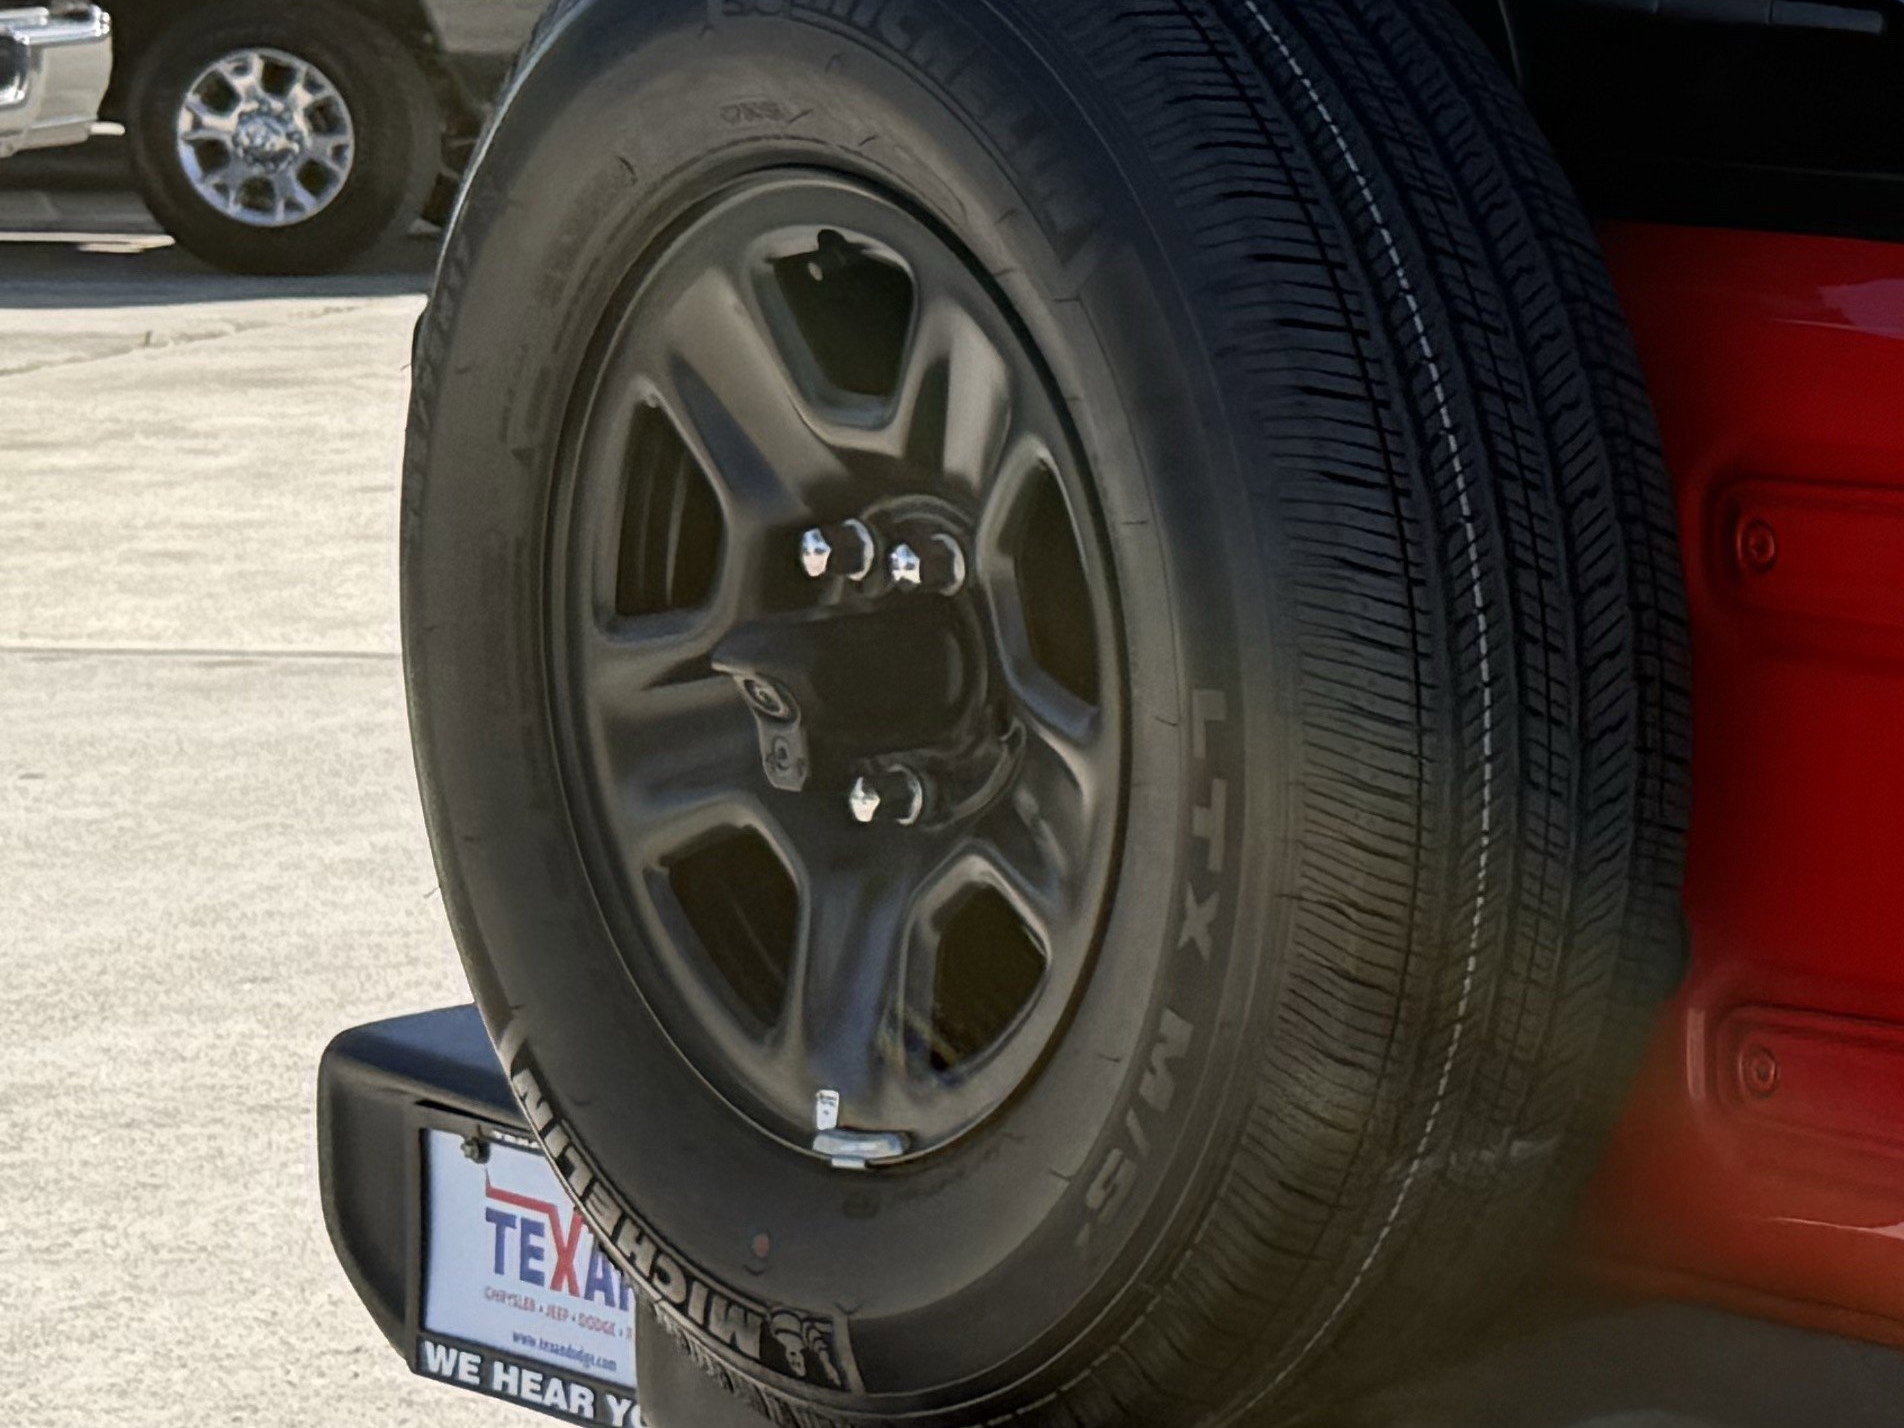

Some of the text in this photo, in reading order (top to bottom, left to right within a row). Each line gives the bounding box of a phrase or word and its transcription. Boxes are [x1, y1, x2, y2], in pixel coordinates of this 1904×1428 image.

[1178, 687, 1227, 961] LTX
[484, 1285, 536, 1314] CHRYSLER
[512, 1069, 763, 1359] MICHELIN
[424, 1339, 482, 1385] WE
[491, 1360, 596, 1419] HEAR
